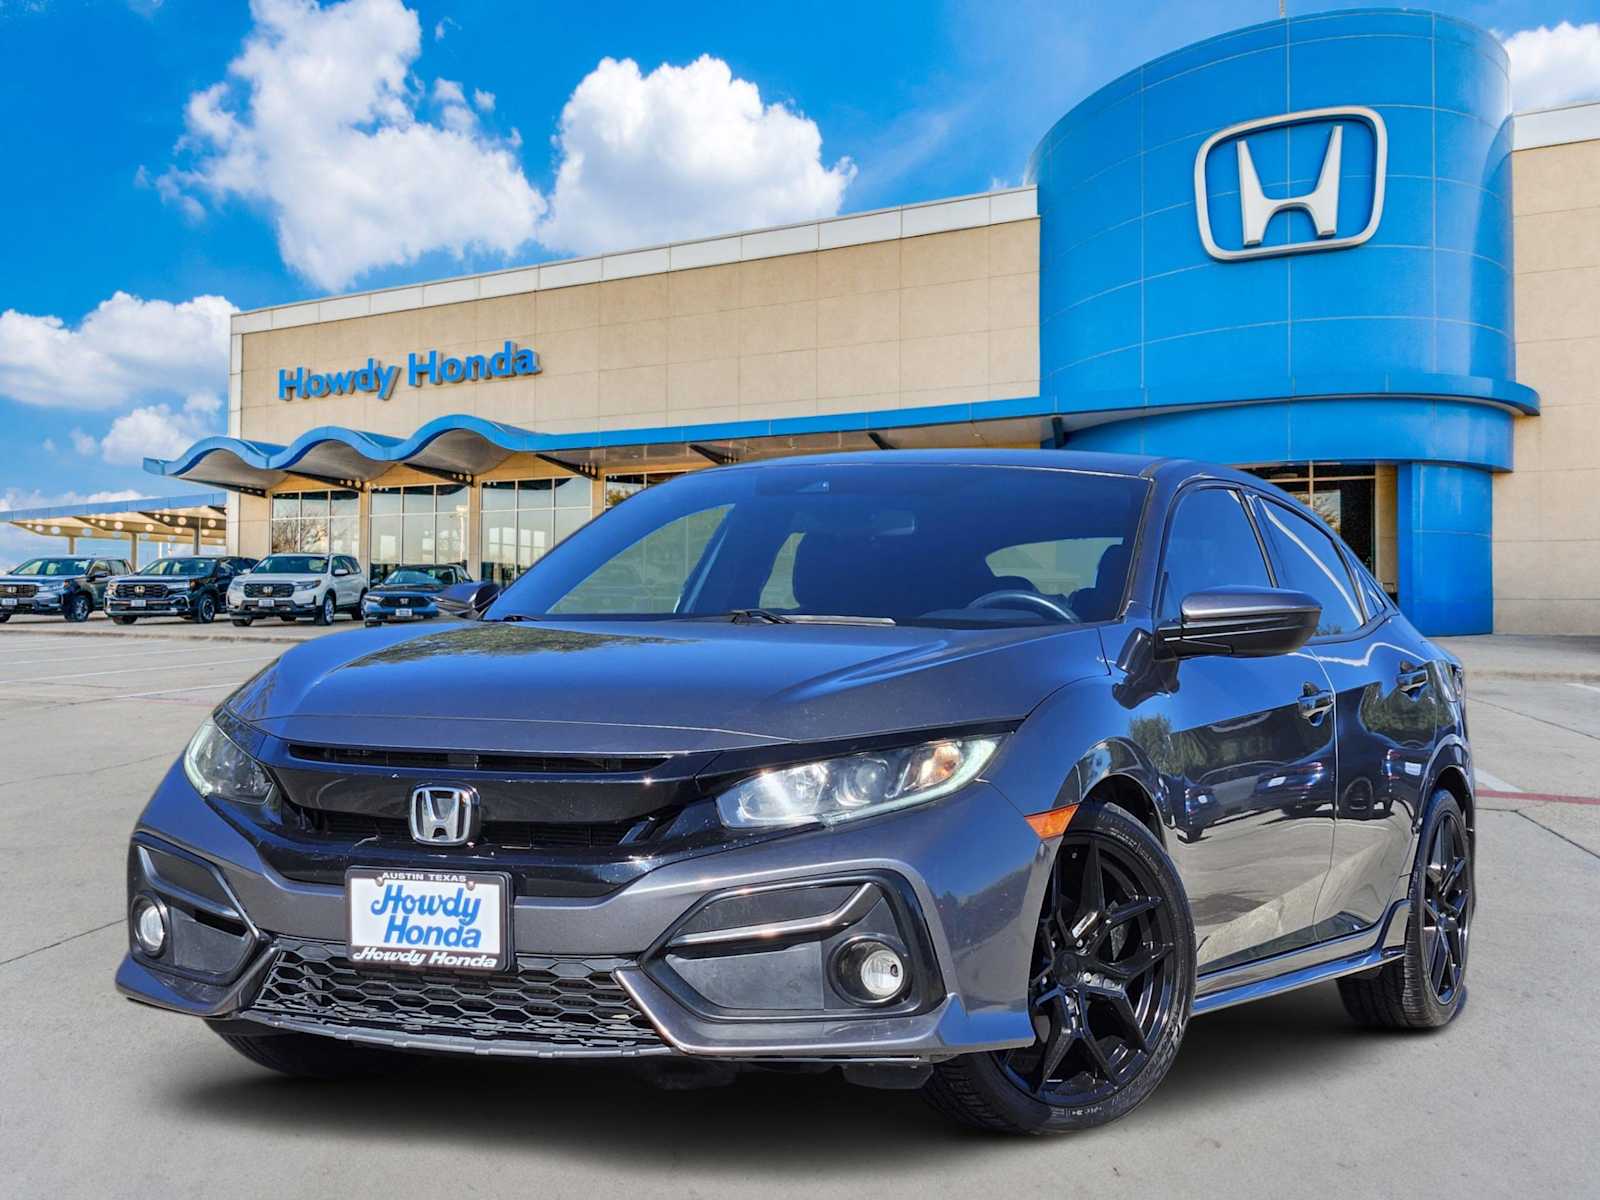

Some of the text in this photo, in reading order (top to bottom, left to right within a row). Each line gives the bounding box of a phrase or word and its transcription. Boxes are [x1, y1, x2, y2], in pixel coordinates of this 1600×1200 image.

[278, 340, 542, 400] Howdy Honda
[382, 872, 467, 882] AUSTIN TEXAS
[371, 884, 481, 926] Howdy
[384, 915, 482, 948] Honda
[352, 946, 497, 968] Howdy Honda
